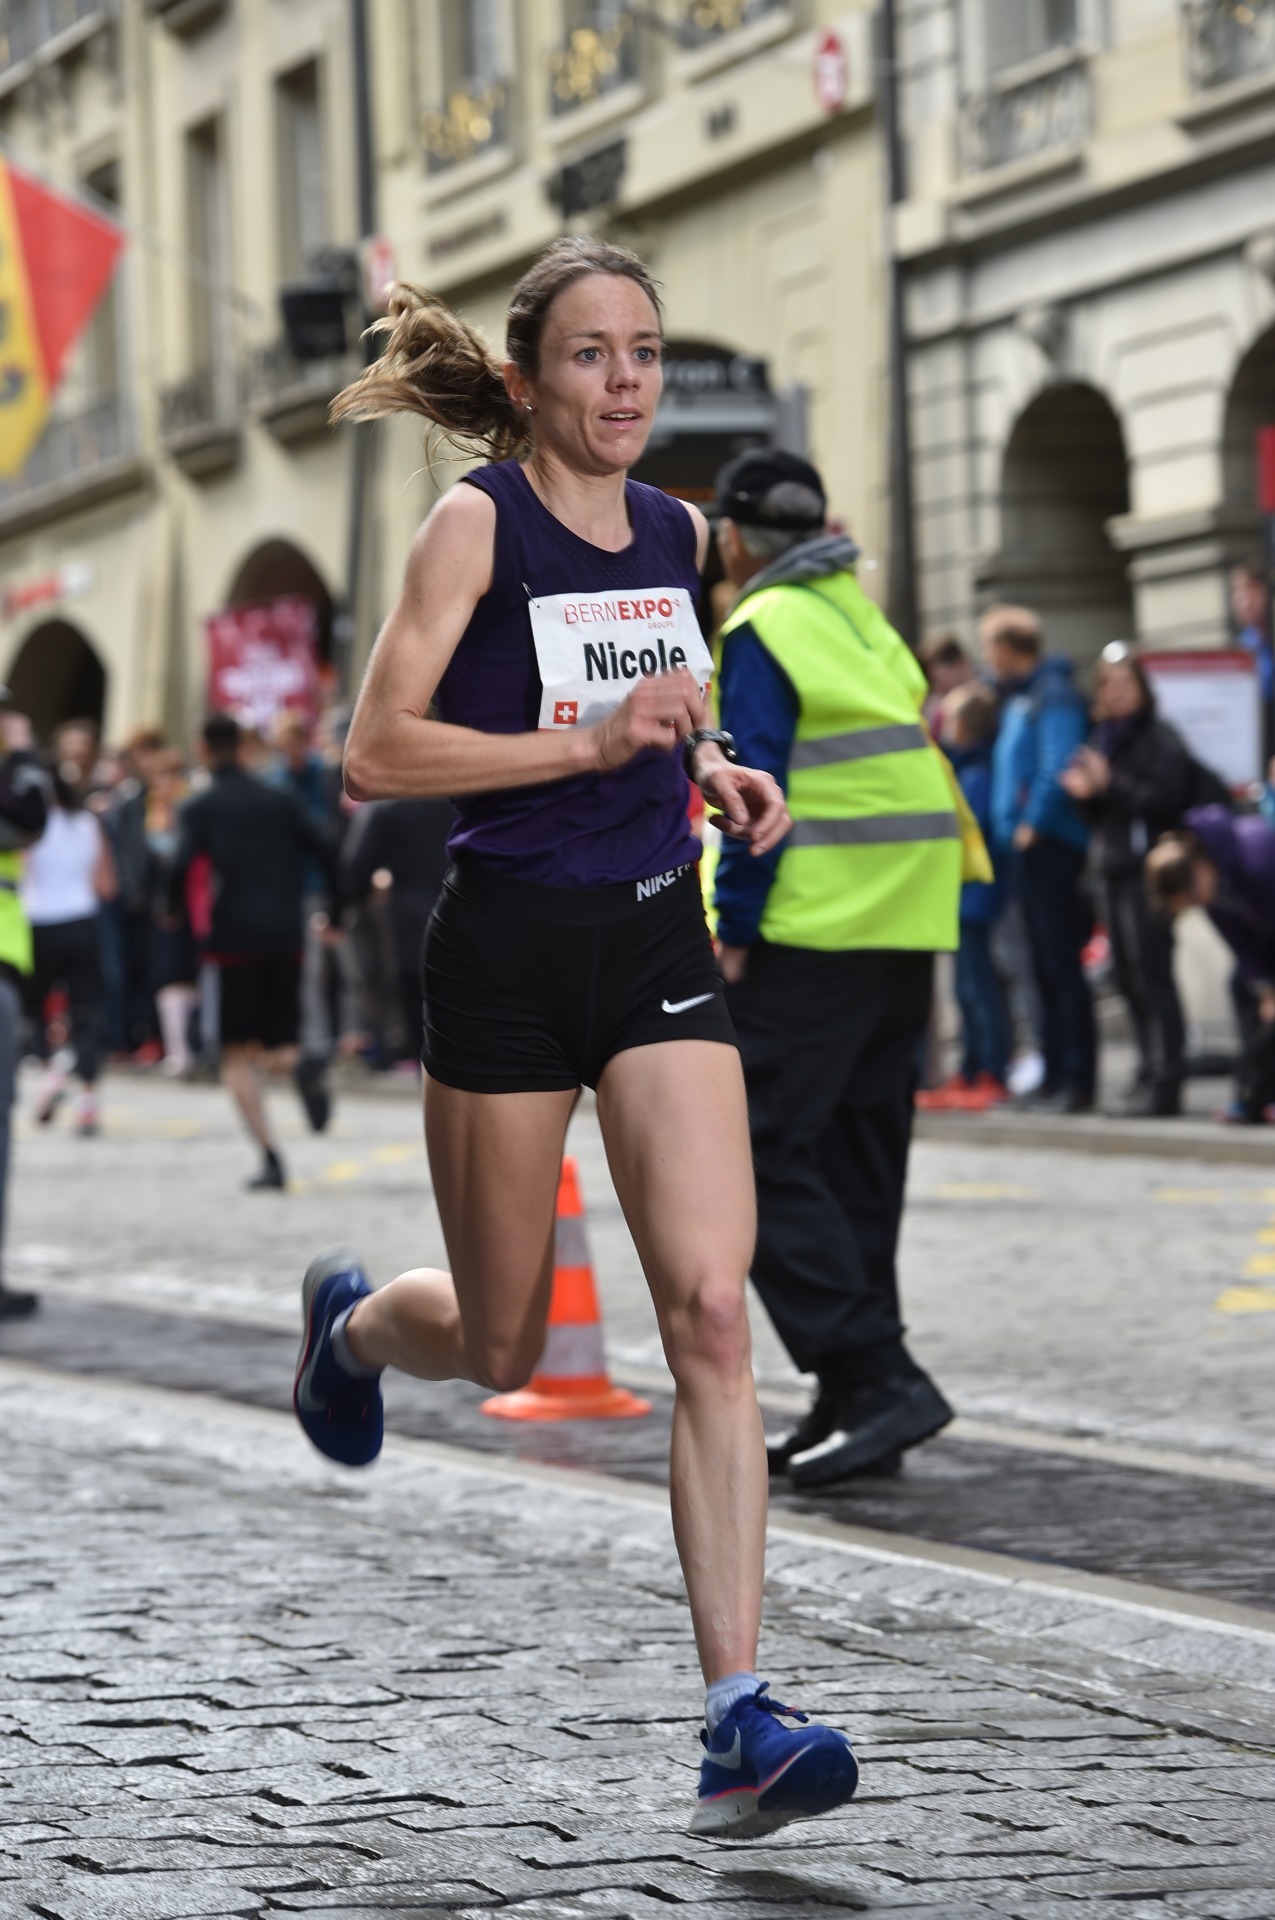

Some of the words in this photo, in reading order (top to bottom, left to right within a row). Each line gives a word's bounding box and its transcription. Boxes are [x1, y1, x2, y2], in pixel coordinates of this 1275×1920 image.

[563, 597, 673, 625] BERNEXPO
[647, 620, 675, 630] GROUPE
[582, 637, 688, 682] Nicole
[636, 869, 677, 902] NIKE
